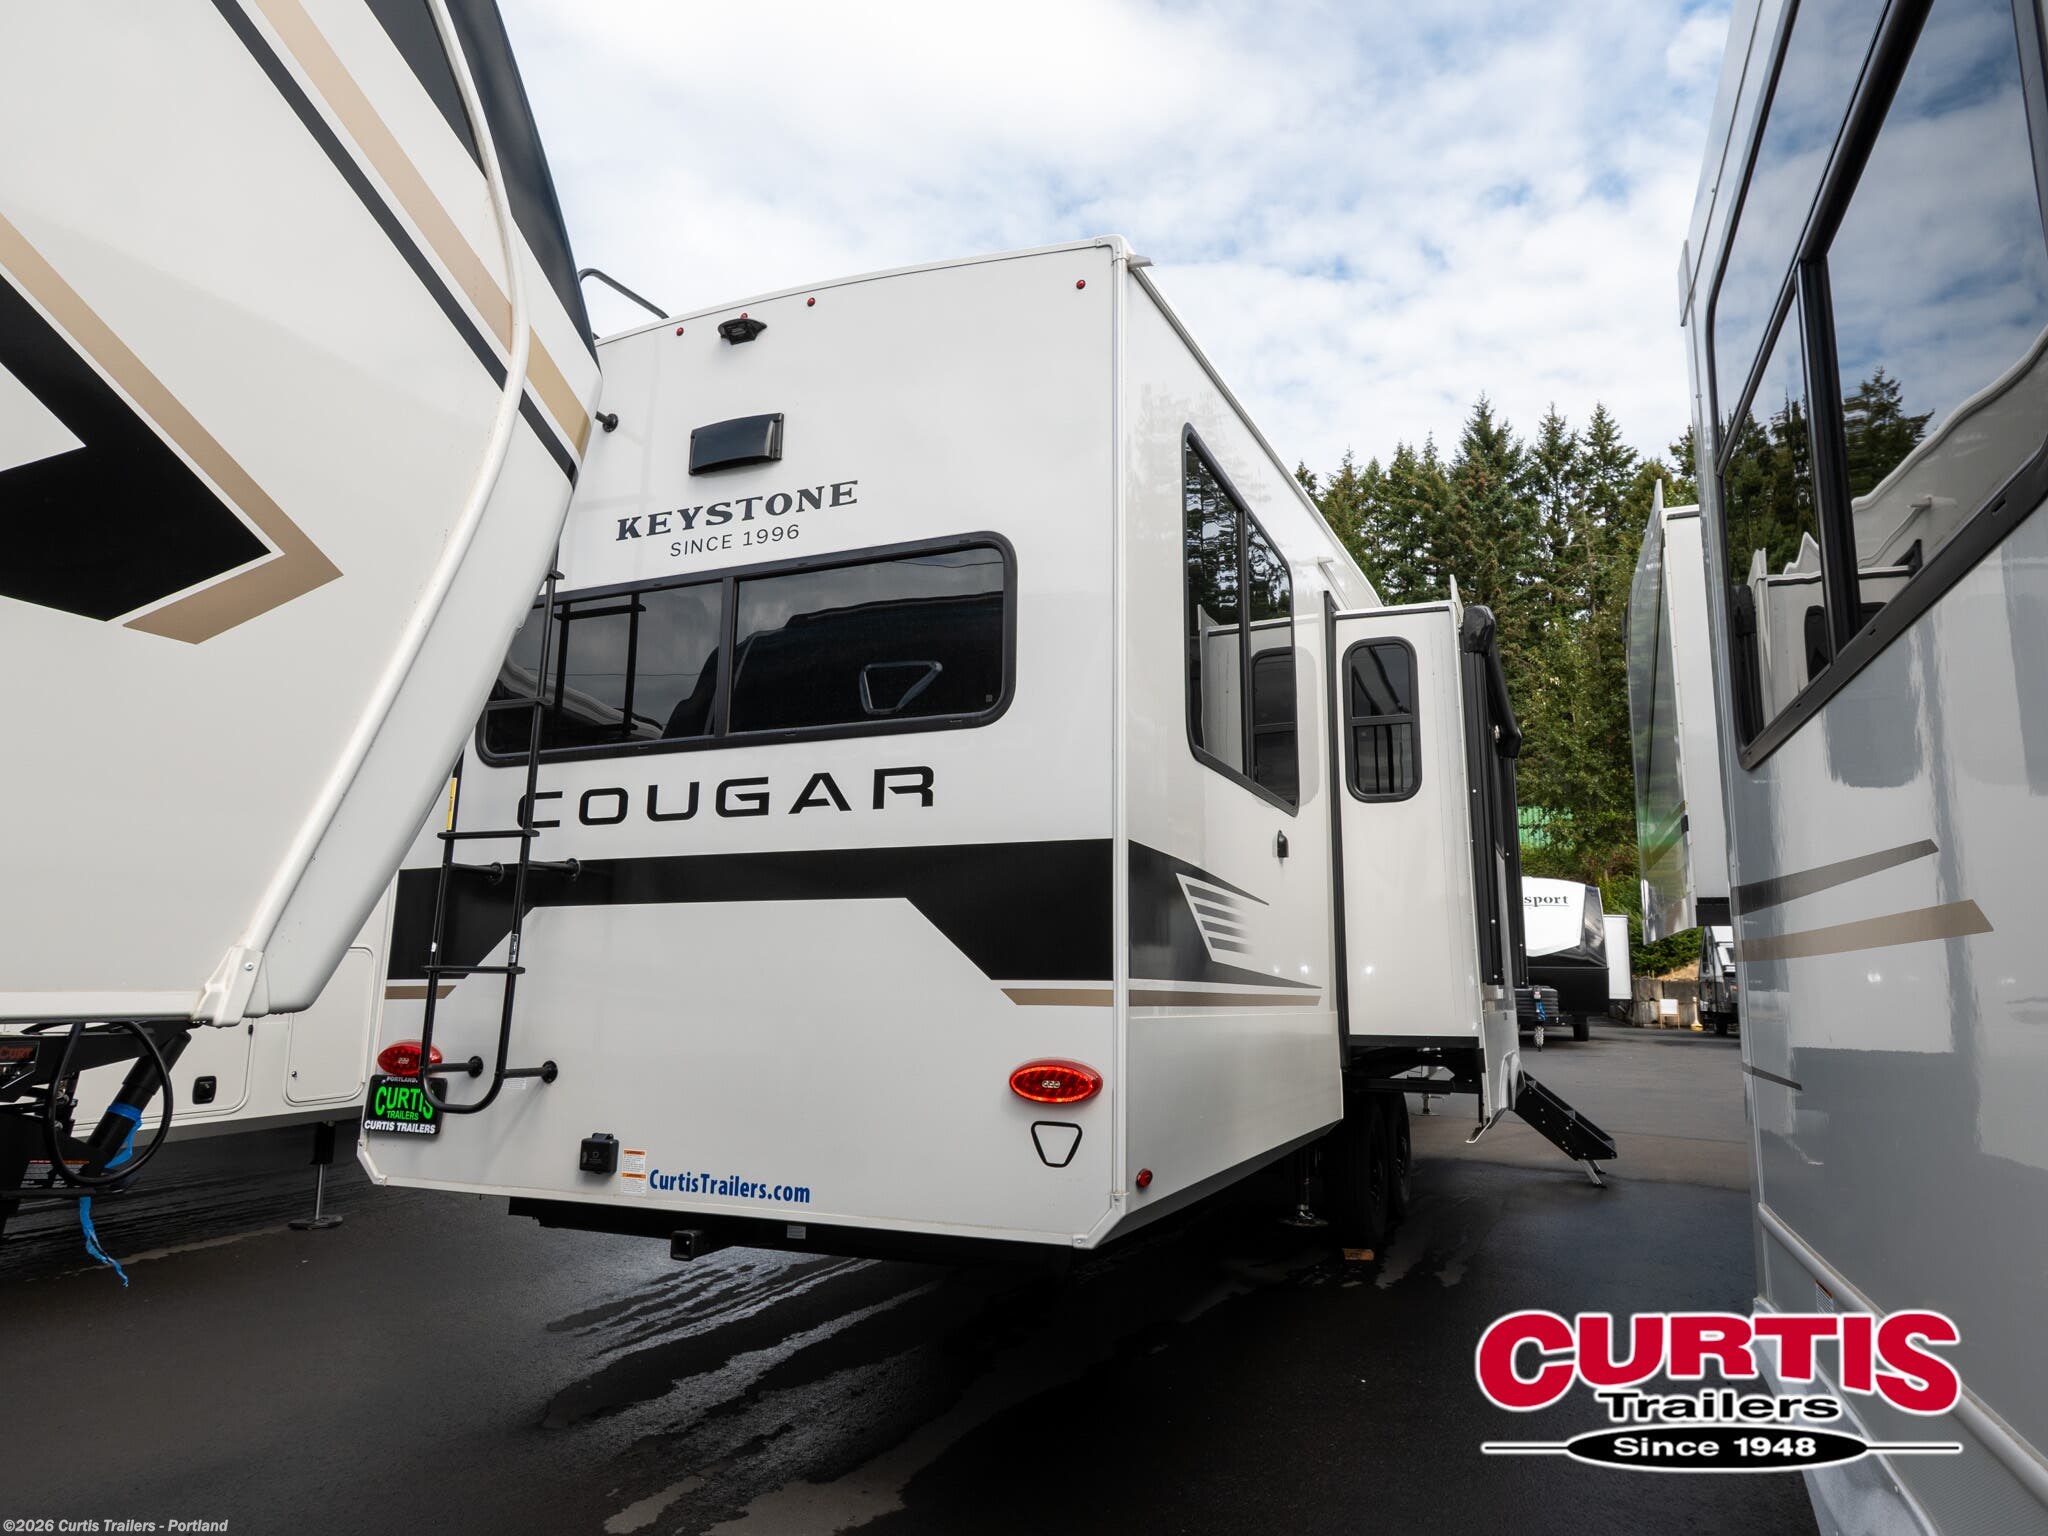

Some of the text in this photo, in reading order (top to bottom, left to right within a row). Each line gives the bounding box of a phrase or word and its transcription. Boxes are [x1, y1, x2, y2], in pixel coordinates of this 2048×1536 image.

[615, 480, 858, 541] KEYSTONE
[670, 523, 800, 557] SINCE 1996
[517, 765, 935, 829] COUGAR
[375, 1086, 434, 1119] CURTIS
[386, 1110, 419, 1120] TRAILERS
[364, 1120, 436, 1134] CURTIS TRAILERS
[649, 1169, 810, 1203] CurtisTrailers.com
